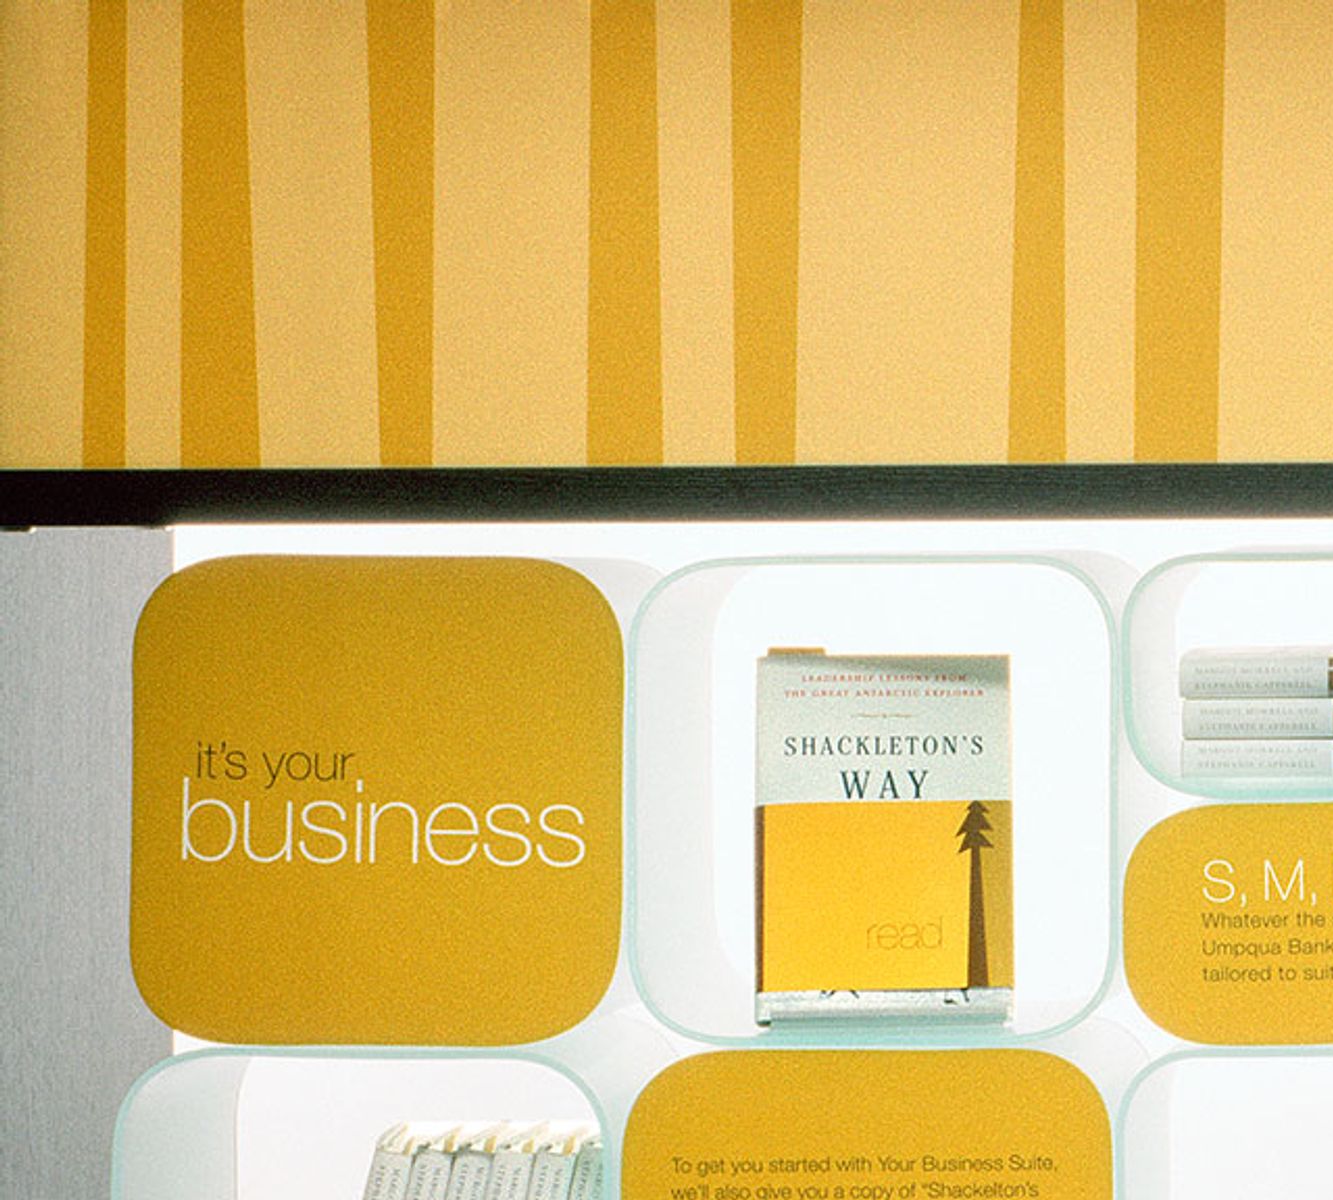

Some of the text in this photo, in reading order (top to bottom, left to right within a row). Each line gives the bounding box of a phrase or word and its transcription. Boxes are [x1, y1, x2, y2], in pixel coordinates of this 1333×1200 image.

[801, 673, 968, 682] LEADERSHIP LESSONS FROM
[784, 688, 984, 698] THE GREAT ANTARCTIC EXPLORER
[784, 735, 984, 756] SHACKLETON'S
[196, 742, 356, 788] it's your
[840, 769, 929, 799] WAY
[181, 777, 586, 867] business
[1202, 858, 1248, 908] S,
[1263, 858, 1318, 905] M,
[1201, 912, 1288, 928] Whatever
[1296, 911, 1325, 928] the
[866, 915, 944, 950] read
[1202, 939, 1281, 960] Umpqua
[1203, 965, 1272, 982] tailored
[1278, 965, 1297, 981] to
[672, 1155, 1058, 1178] To get you started with Your Business Suite,
[671, 1184, 709, 1199] we'll
[715, 1184, 751, 1199] also
[834, 1188, 845, 1199] a
[898, 1183, 916, 1199] of
